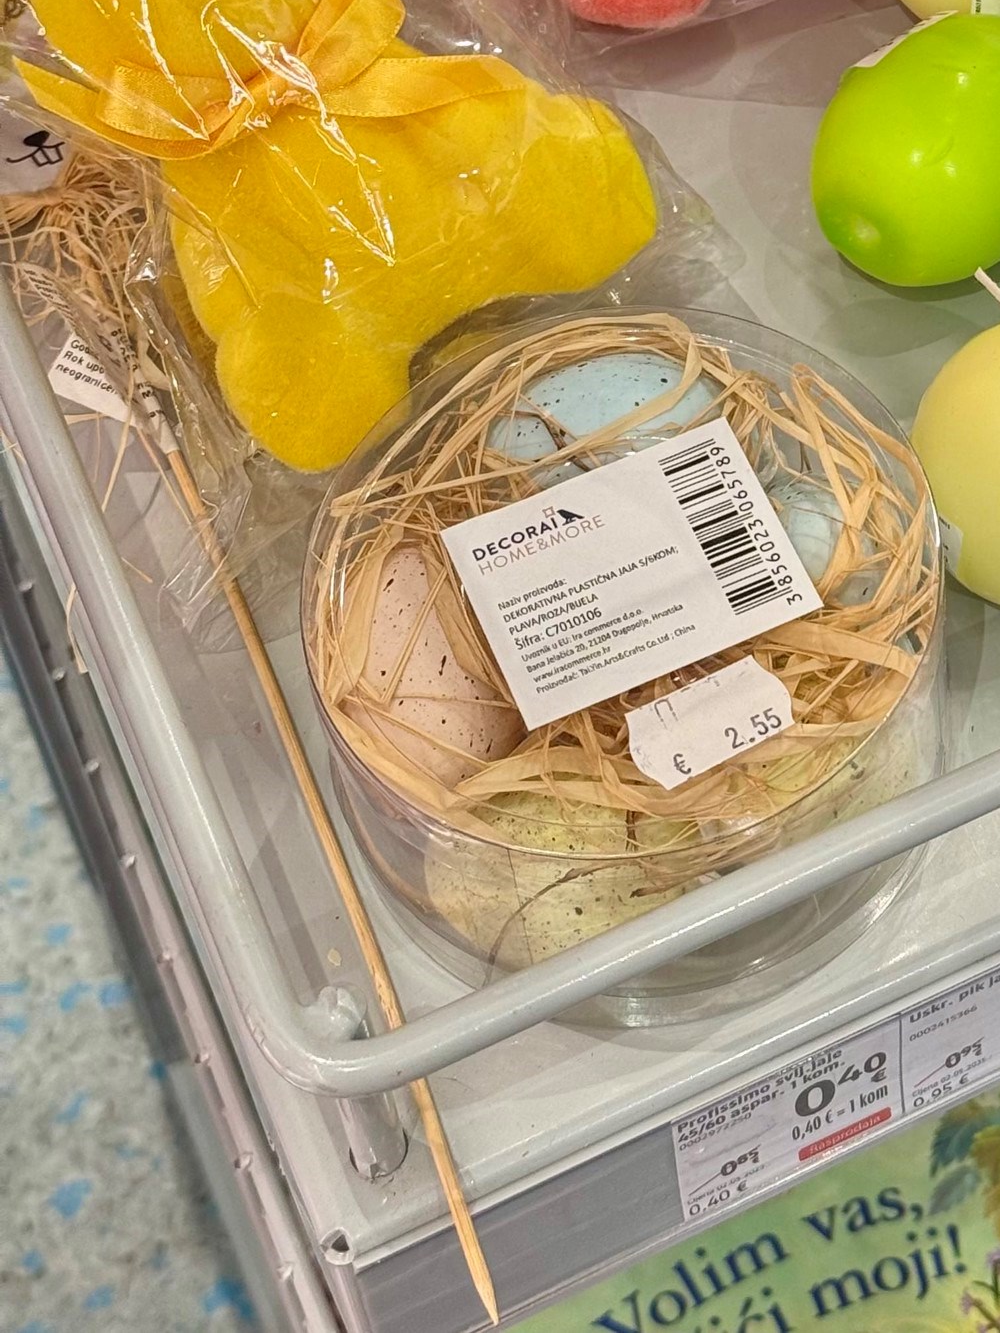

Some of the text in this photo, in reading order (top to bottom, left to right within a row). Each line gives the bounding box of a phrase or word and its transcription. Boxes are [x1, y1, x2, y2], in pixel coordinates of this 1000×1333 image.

[478, 515, 605, 575] HOME&MORE
[498, 596, 521, 611] Naziv
[503, 591, 567, 623] DEKORATIVNA
[568, 570, 618, 598] PLASTIČNA
[618, 562, 639, 577] JAJA
[508, 593, 599, 635] PLAVA/ROZA/BIJELA
[514, 606, 602, 651] Šifra: C7010106
[521, 645, 551, 662] Uvoznik
[552, 642, 559, 650] u
[584, 617, 622, 637] commerce
[526, 660, 546, 673] Bana
[588, 632, 612, 647] 21204
[612, 618, 651, 639] Dugopolje,
[651, 603, 684, 621] Hrvatska
[674, 623, 696, 638] China
[533, 645, 612, 683] www.iracommerce.hr
[724, 707, 782, 749] 2.55
[909, 1001, 953, 1024] Uskr.
[677, 1083, 771, 1134] Profissimo
[678, 1115, 727, 1143] 45/60
[730, 1089, 785, 1120] aspar.
[803, 1060, 846, 1084] kom.
[791, 1116, 822, 1141] 0,40
[825, 1109, 834, 1124] €
[849, 1099, 856, 1113] 1
[859, 1085, 889, 1109] kom
[689, 1179, 749, 1216] 0,40 €
[801, 1186, 923, 1242] vas,
[808, 1222, 967, 1318] moji!
